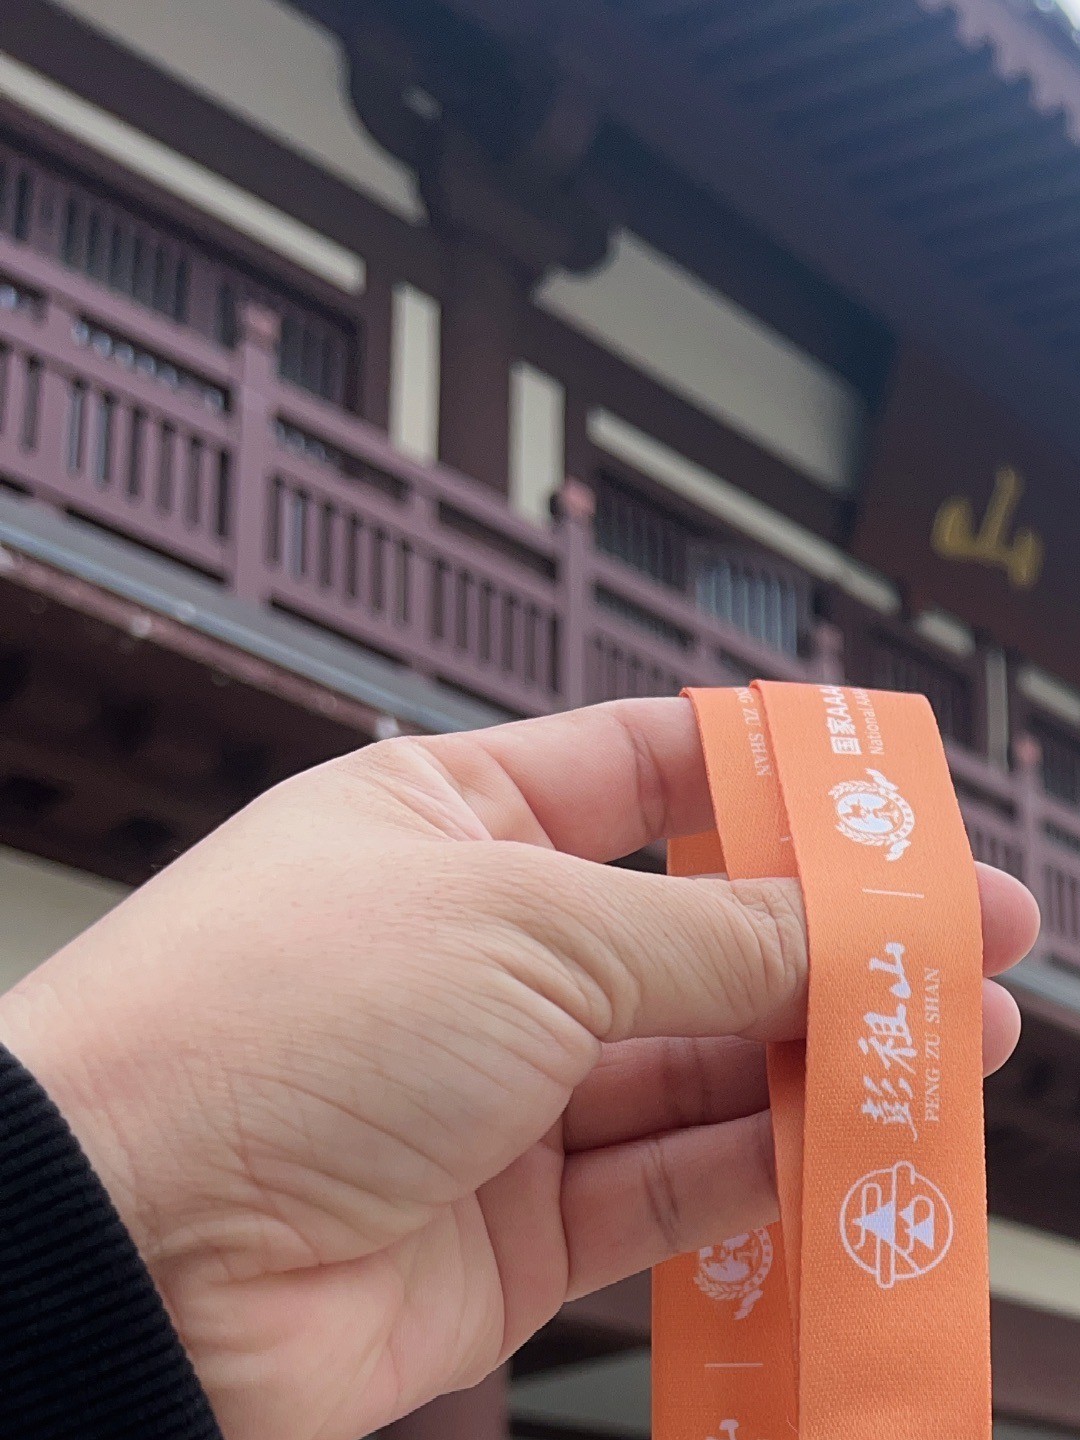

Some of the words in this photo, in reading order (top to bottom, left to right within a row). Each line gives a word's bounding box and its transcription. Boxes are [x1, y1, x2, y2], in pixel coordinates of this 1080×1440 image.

[749, 733, 771, 776] SHAN
[861, 707, 885, 755] National
[924, 967, 941, 1024] SHAN
[858, 942, 918, 1143] 彭祖山
[924, 1032, 941, 1060] ZU
[924, 1067, 941, 1122] PENG
